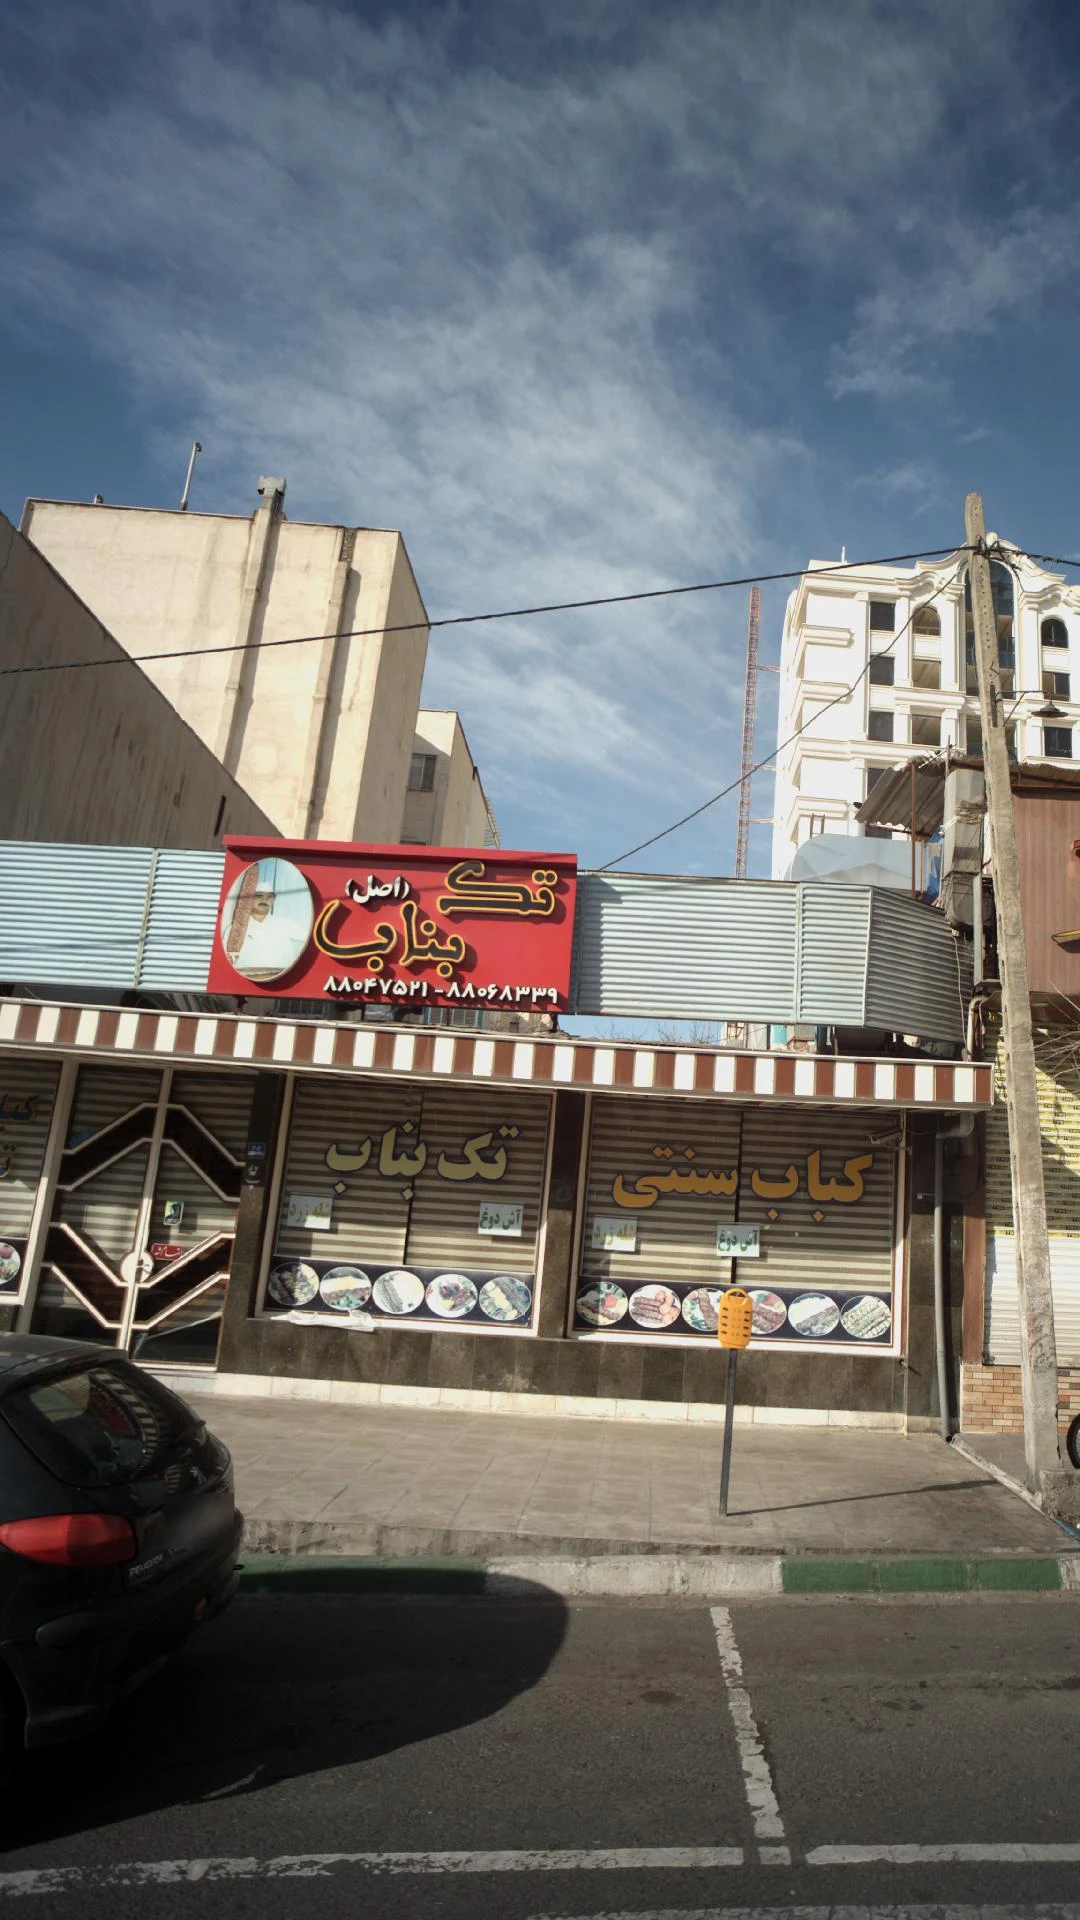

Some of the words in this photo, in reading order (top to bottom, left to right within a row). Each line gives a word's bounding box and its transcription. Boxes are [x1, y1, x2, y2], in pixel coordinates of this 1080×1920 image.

[345, 874, 409, 904] (اصل)
[437, 860, 557, 916] تک
[314, 899, 465, 977] بناب
[325, 1120, 427, 1201] بناب
[437, 1125, 521, 1181] تک
[611, 1145, 738, 1209] سنتی
[751, 1148, 874, 1224] کباب
[479, 1207, 500, 1230] دوغ
[502, 1208, 521, 1230] آش
[718, 1229, 738, 1252] دوغ
[740, 1229, 758, 1252] آش
